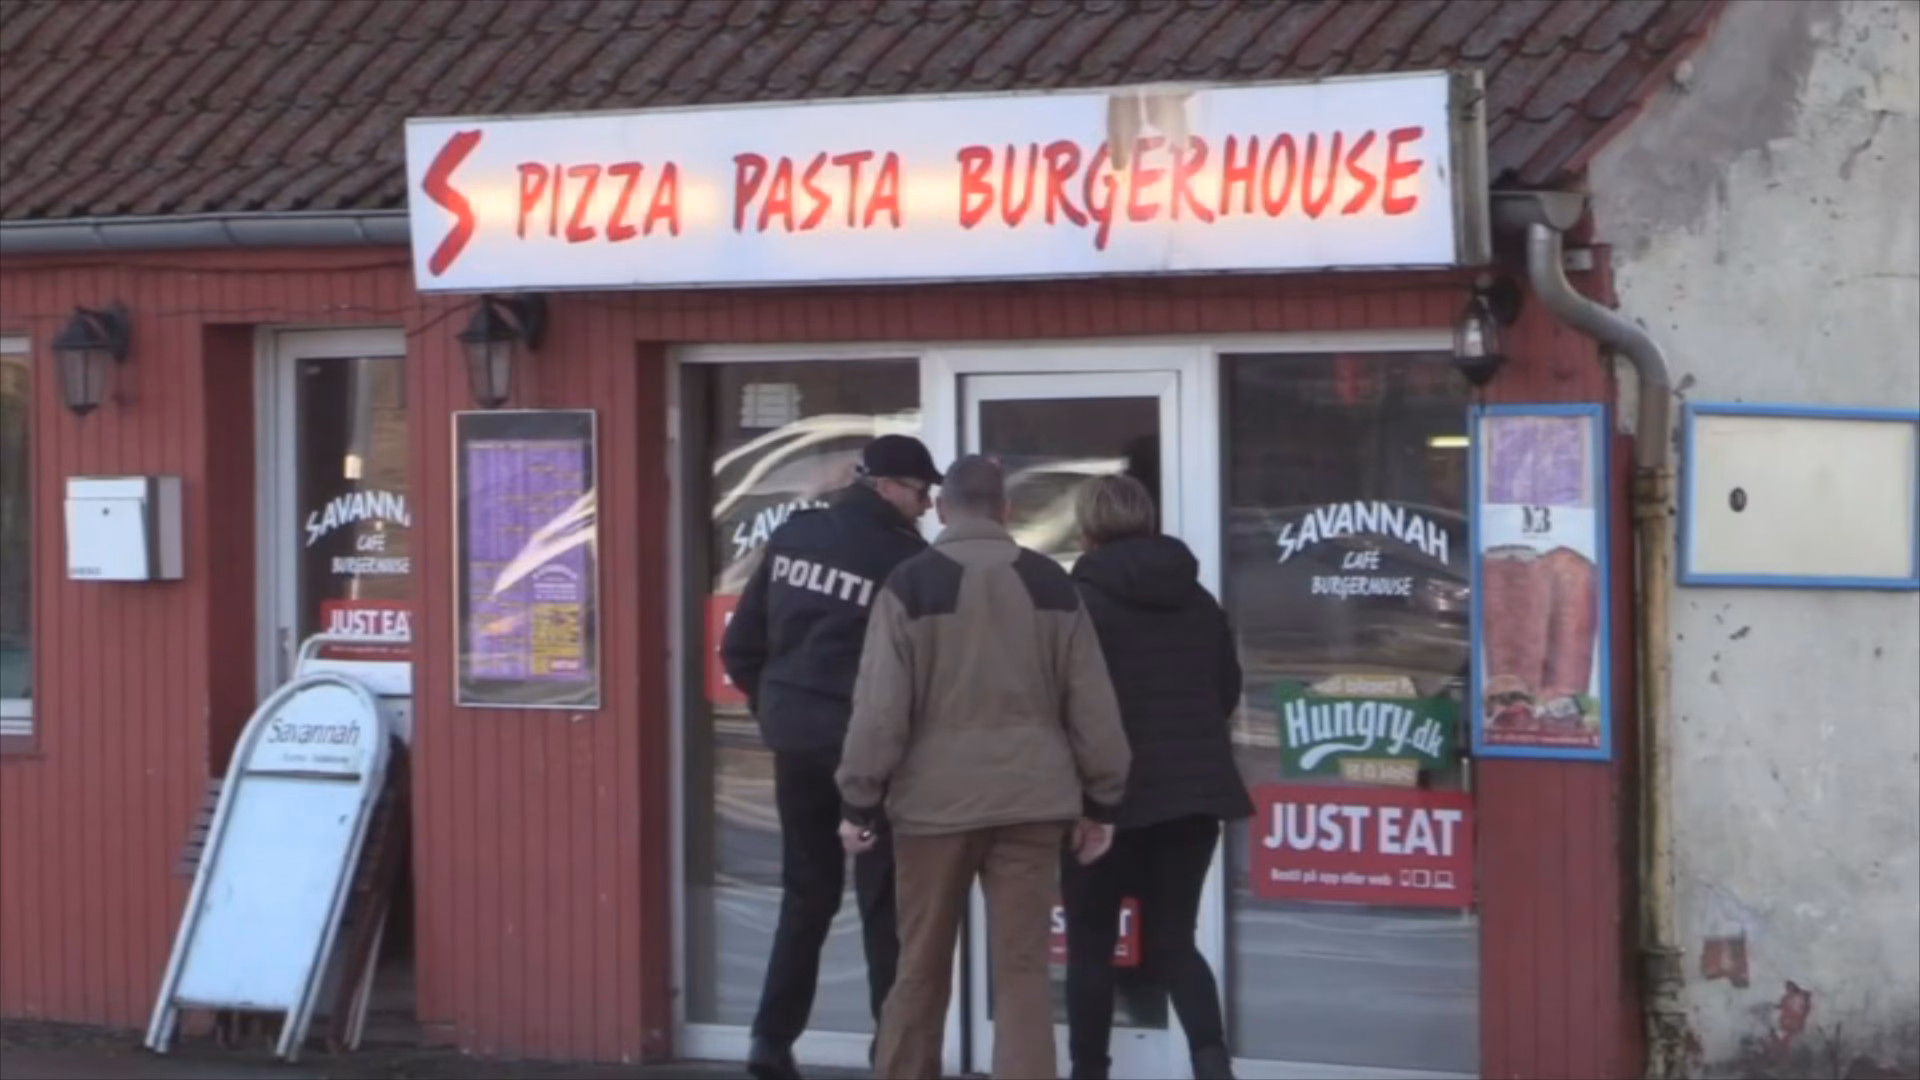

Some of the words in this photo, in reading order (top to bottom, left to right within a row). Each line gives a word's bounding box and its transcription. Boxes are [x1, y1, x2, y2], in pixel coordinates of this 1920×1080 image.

[517, 161, 680, 243] PIZZA
[733, 150, 901, 233] PASTA
[957, 126, 1424, 251] BURGERHOUSE
[305, 490, 412, 547] SAVANN
[1277, 500, 1450, 565] SAVANNAH
[771, 555, 874, 607] POLITI
[327, 609, 378, 638] JUST
[383, 609, 413, 642] EA
[267, 718, 361, 745] Savannah
[1263, 802, 1370, 852] JUST
[1378, 807, 1462, 857] EAT
